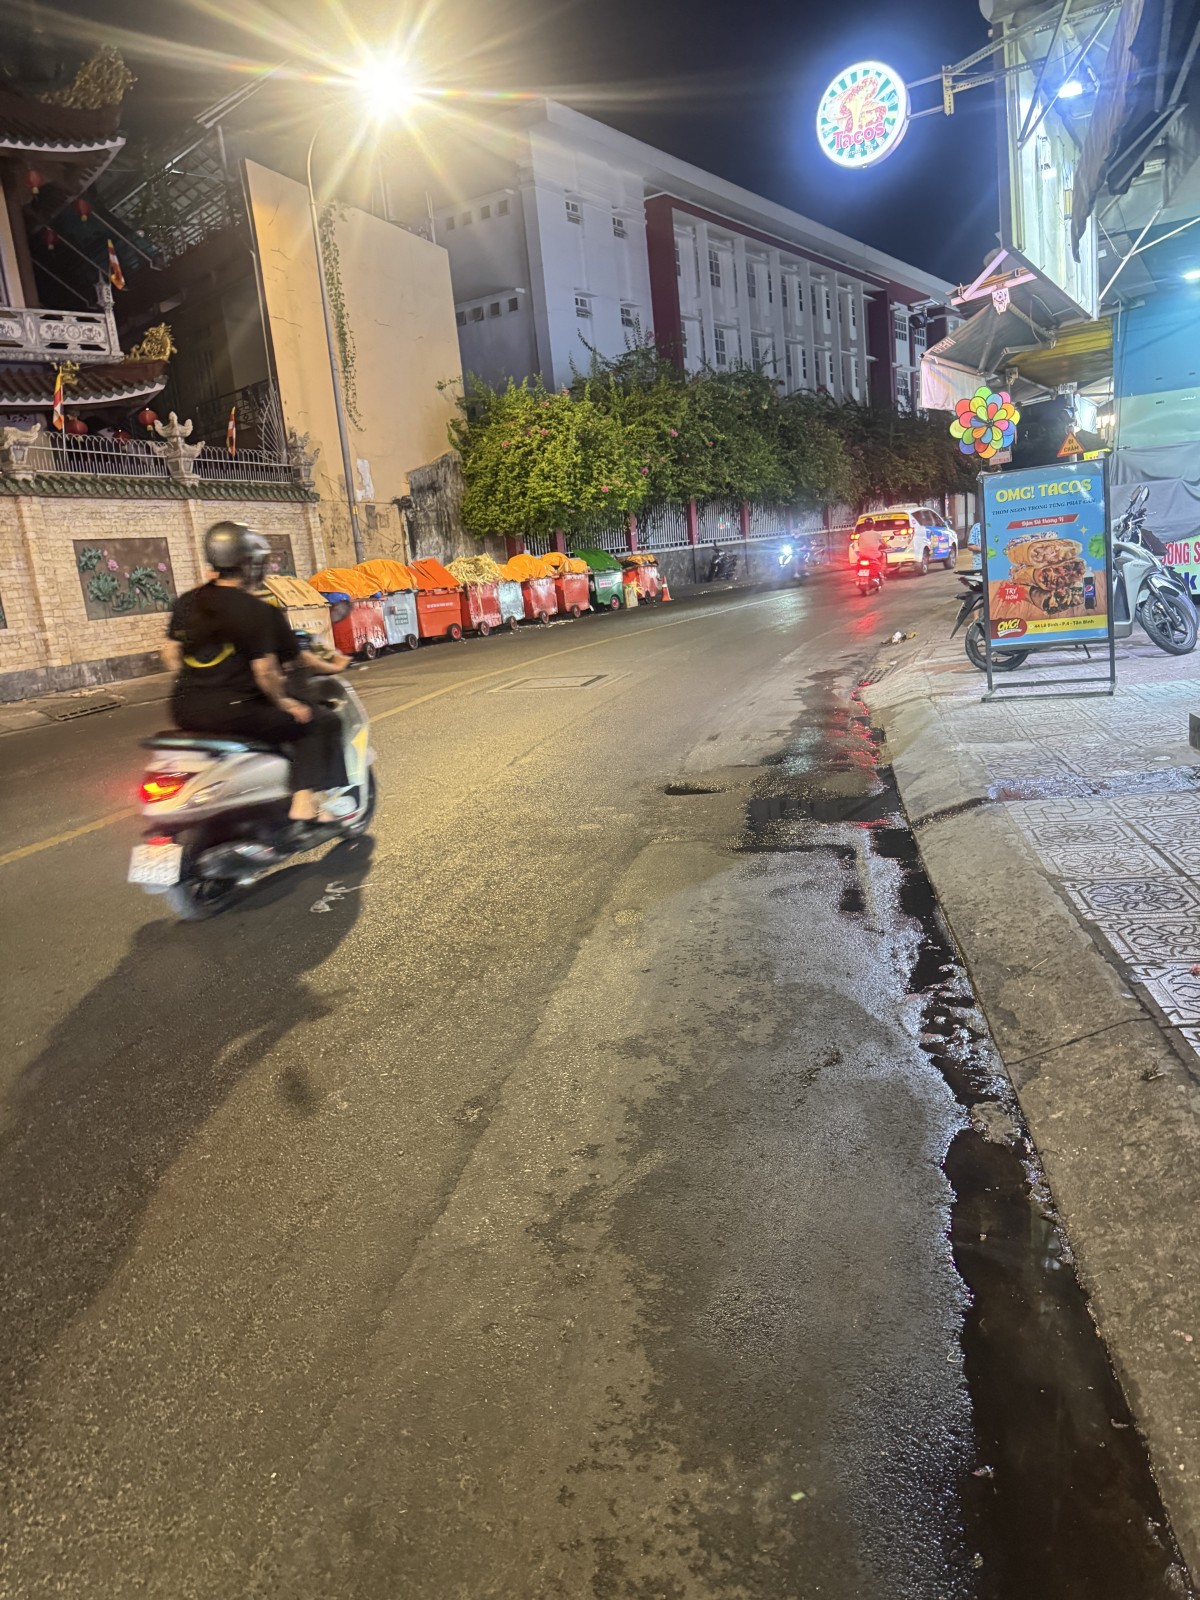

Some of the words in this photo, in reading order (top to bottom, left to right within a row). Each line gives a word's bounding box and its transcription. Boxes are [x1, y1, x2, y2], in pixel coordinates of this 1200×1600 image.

[995, 486, 1035, 503] OMG!
[1038, 478, 1092, 497] TACOS
[1005, 586, 1018, 595] TRY
[997, 618, 1021, 632] OMG!
